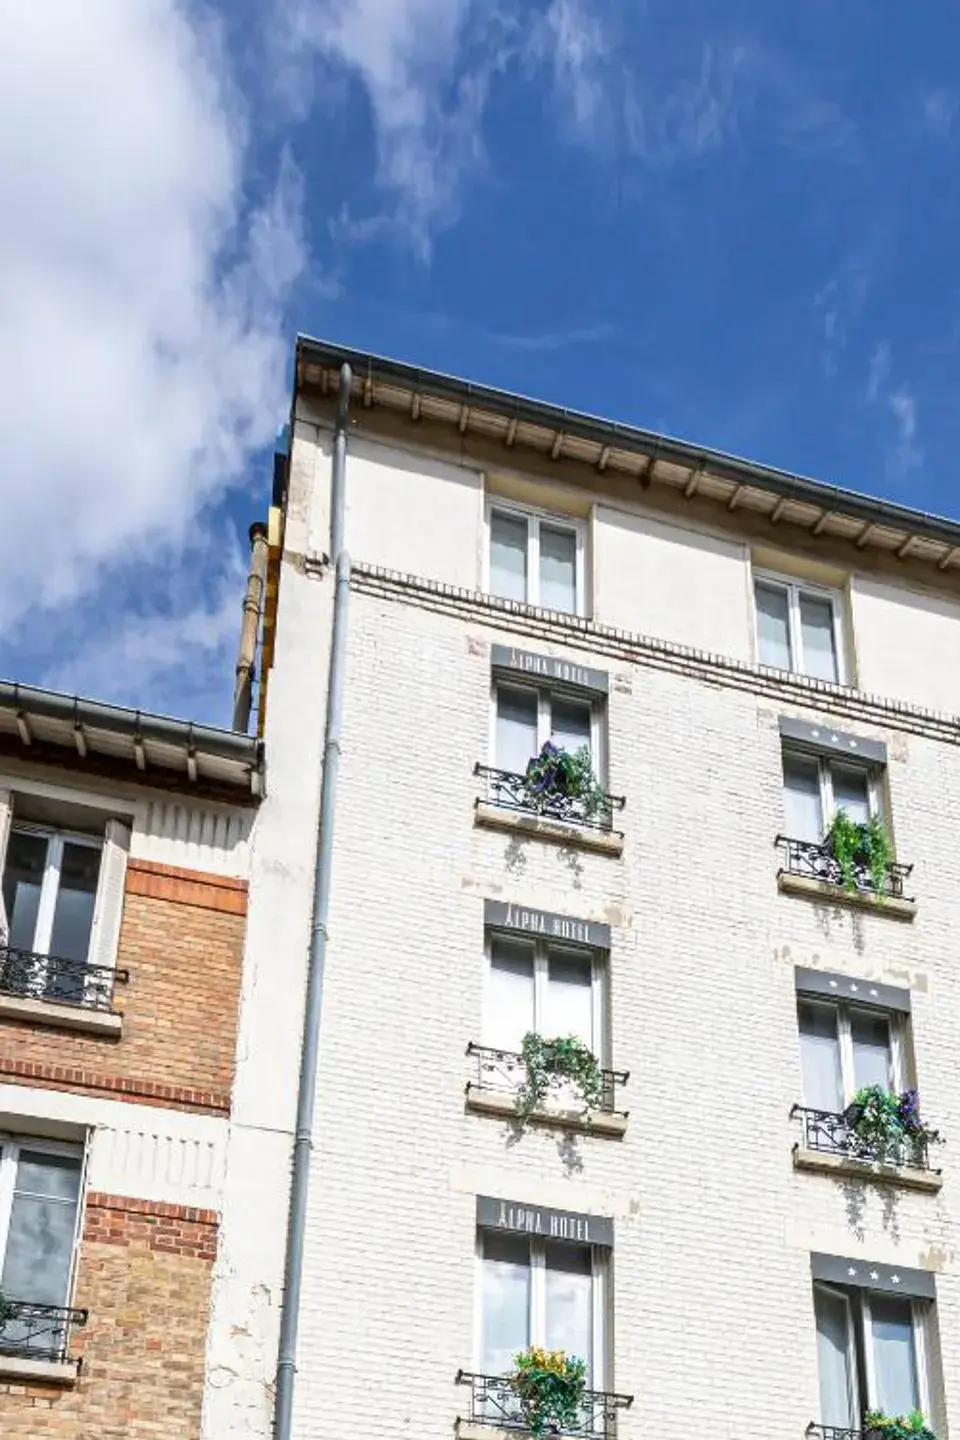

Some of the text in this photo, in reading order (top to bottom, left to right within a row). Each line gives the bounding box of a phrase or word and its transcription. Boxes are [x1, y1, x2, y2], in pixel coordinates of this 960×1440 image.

[509, 648, 548, 676] ALPHA
[504, 901, 590, 943] ALPHA HOTEL
[497, 1201, 589, 1241] ALPHA HOTEL
